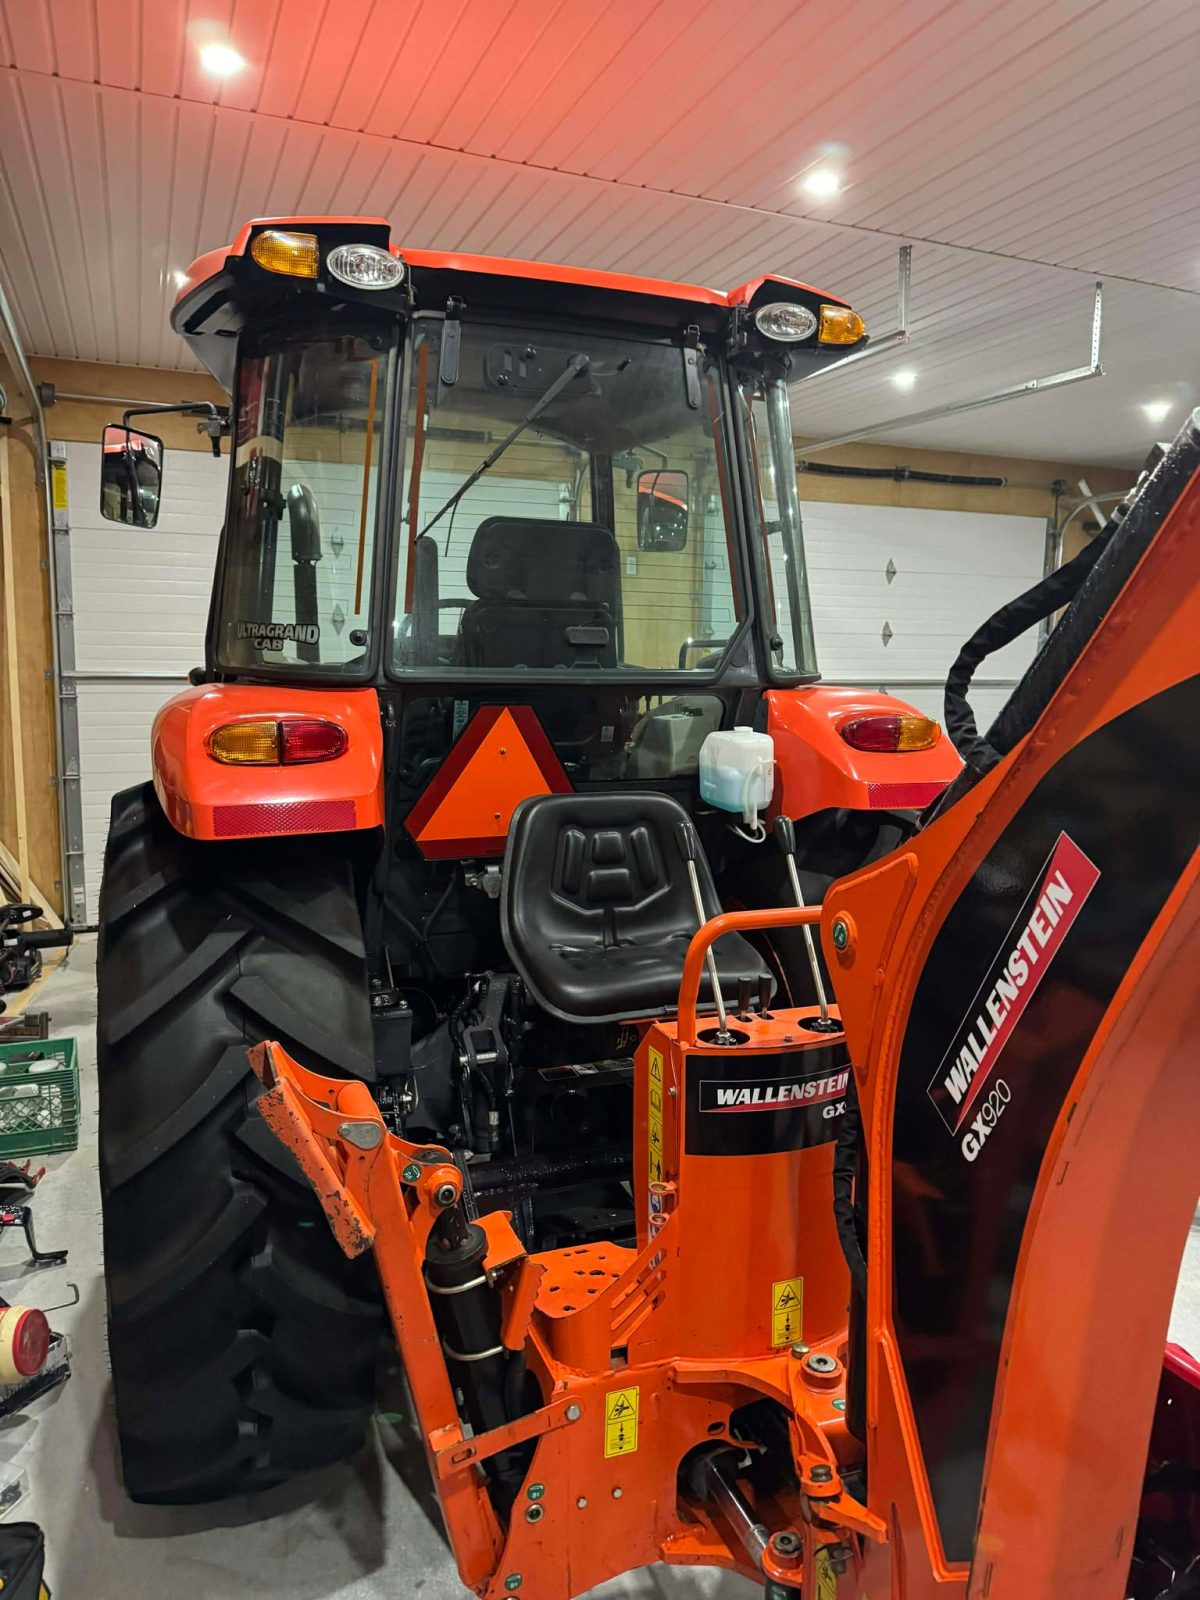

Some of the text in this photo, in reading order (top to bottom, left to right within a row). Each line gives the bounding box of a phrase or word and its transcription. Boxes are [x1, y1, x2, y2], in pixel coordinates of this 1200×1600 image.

[237, 622, 319, 644] ULTRAGRAND
[254, 639, 283, 650] CAB
[943, 869, 1074, 1105] WALLENSTEIN
[961, 1078, 1012, 1162] GX920
